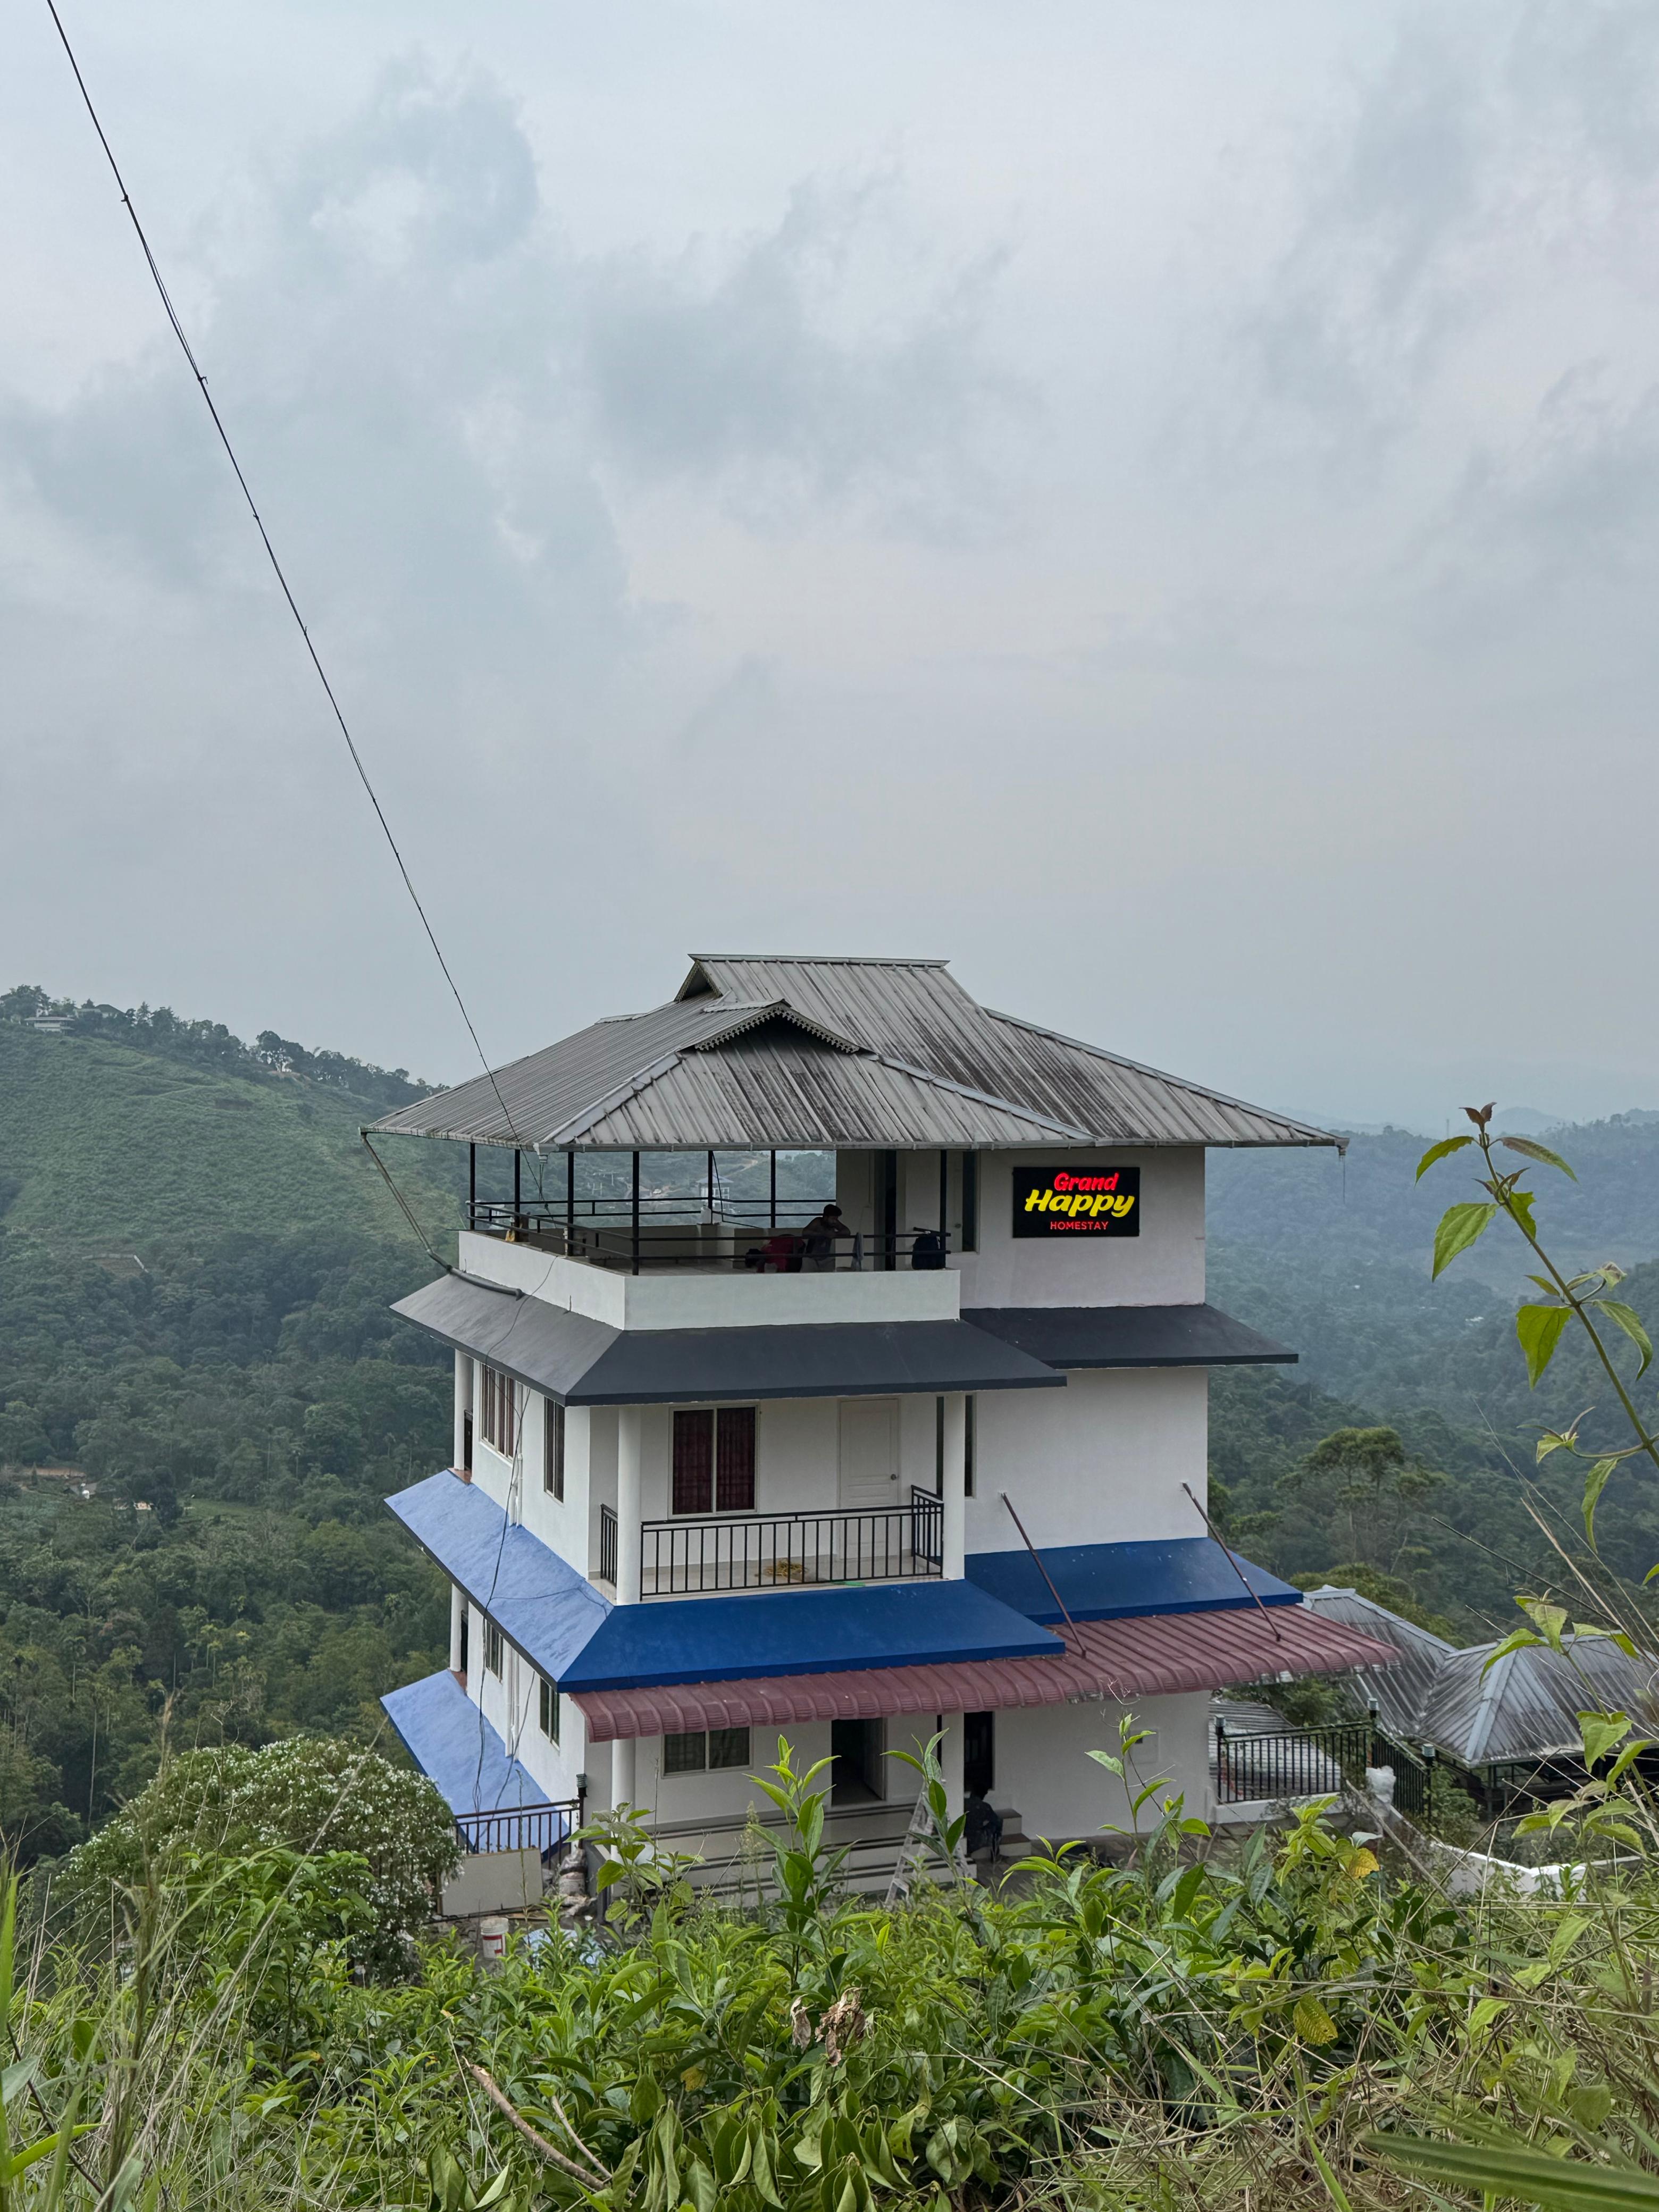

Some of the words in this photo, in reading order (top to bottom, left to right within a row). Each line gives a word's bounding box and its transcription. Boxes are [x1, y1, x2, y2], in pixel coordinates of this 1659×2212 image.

[1054, 1172, 1119, 1191] Grand
[1025, 1189, 1135, 1217] Happy
[1050, 1221, 1109, 1230] HOMESTAY
